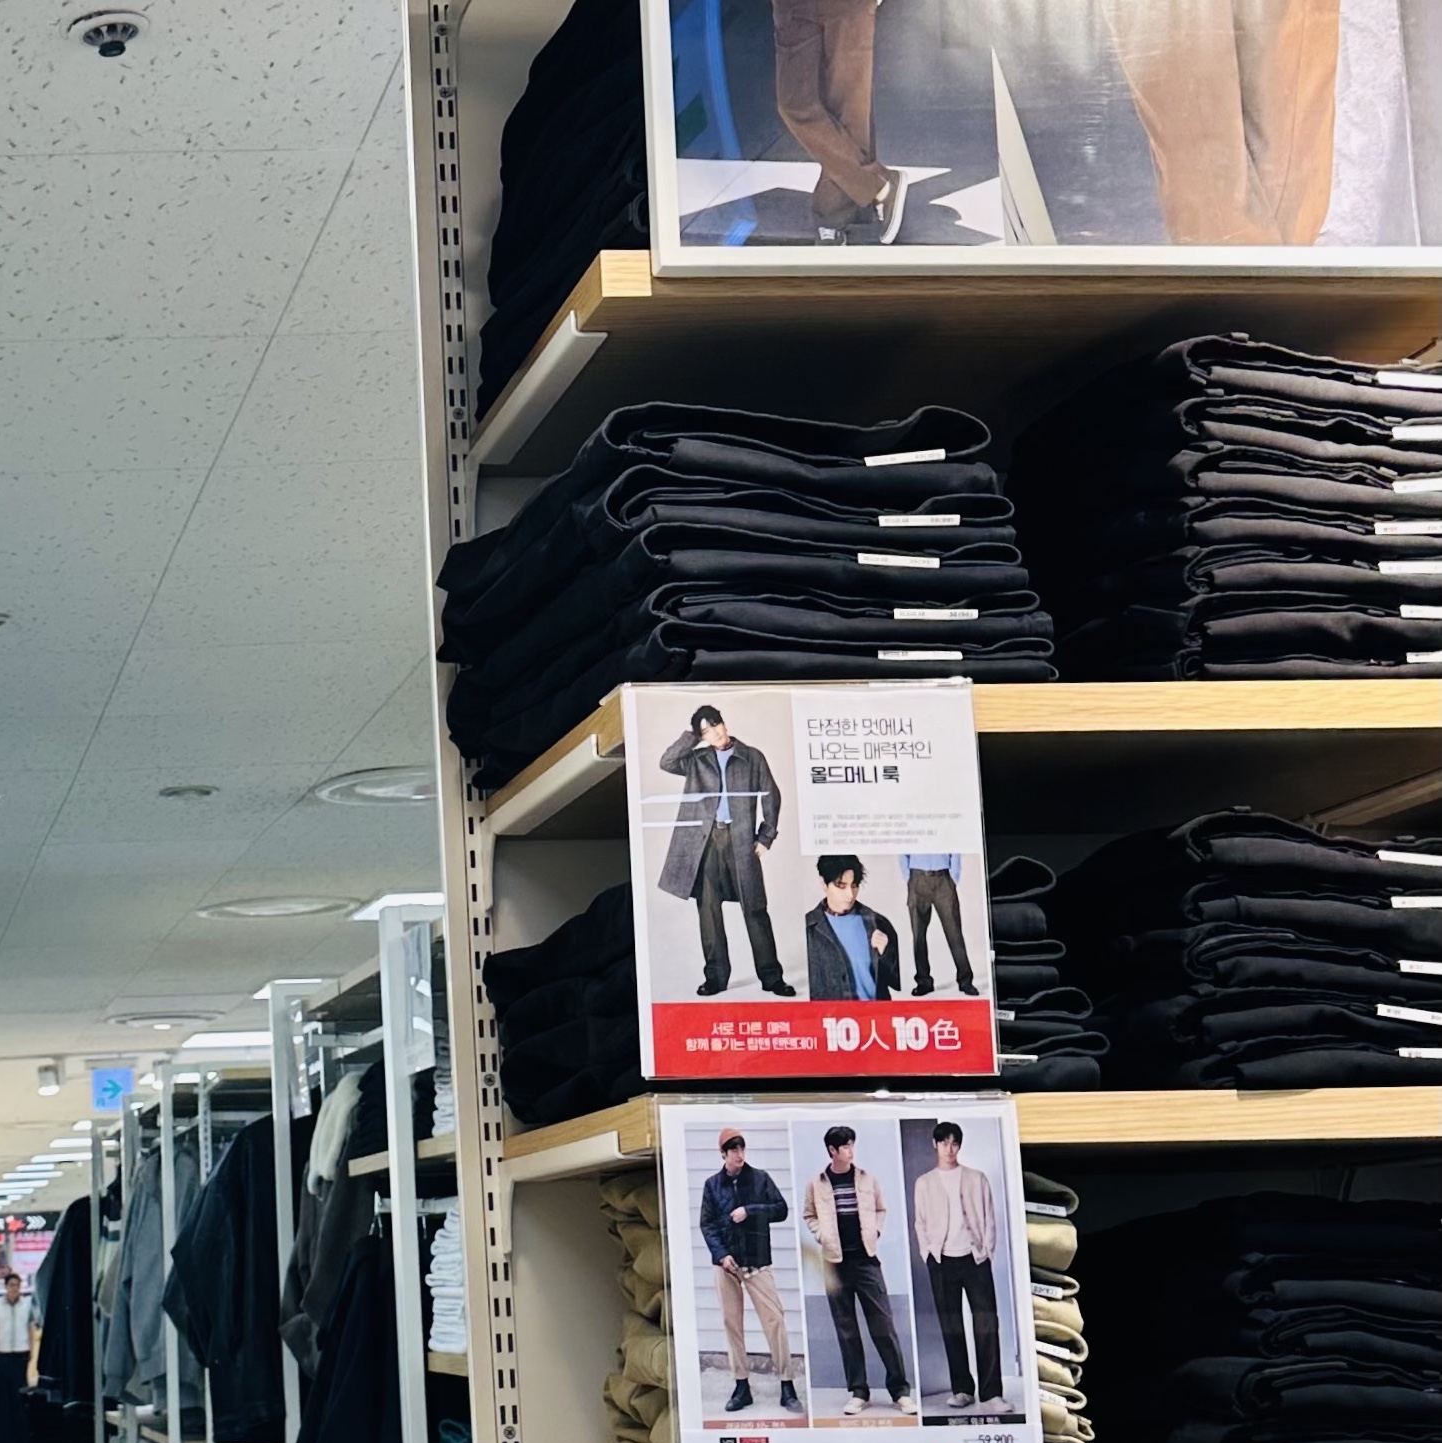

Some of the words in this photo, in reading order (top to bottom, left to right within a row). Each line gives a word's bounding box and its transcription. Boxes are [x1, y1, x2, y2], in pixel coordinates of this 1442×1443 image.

[807, 718, 858, 737] 단정한
[862, 718, 913, 736] 멋에서
[809, 742, 860, 760] 나오는
[864, 740, 932, 759] 매력적인
[810, 765, 878, 784] 올드머니
[882, 765, 900, 783] 룩
[711, 1022, 735, 1035] 서로
[739, 1022, 762, 1035] 다른
[822, 1016, 962, 1051] 10人10色
